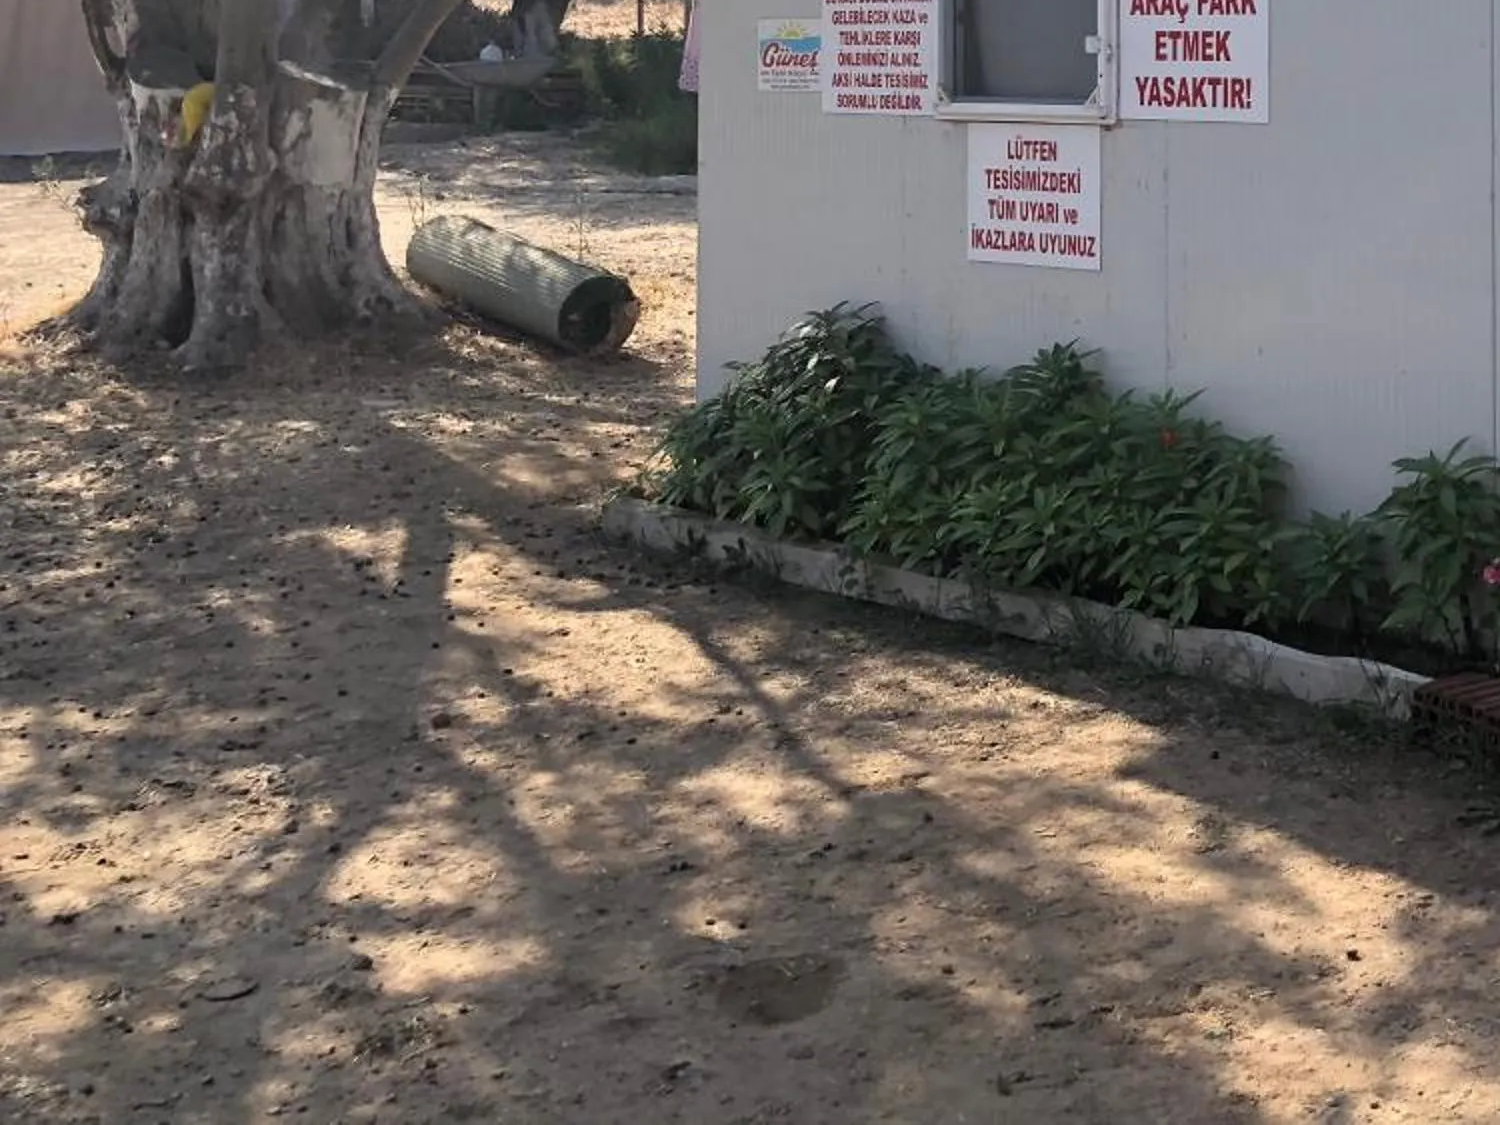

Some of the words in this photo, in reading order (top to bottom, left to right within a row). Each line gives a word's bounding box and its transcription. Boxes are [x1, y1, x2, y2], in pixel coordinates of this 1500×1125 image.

[832, 7, 889, 24] GELEBİLECEK
[892, 9, 917, 24] KAZA
[919, 13, 928, 23] ve
[893, 31, 921, 48] KARŞI
[1155, 30, 1231, 61] ETMEK
[854, 73, 882, 87] HALDE
[1135, 76, 1252, 109] YASAKTIR!
[837, 94, 877, 109] SORUMLU
[1007, 135, 1057, 161] LÜTFEN
[985, 165, 1081, 194] TESİSİMİZDEKİ
[988, 195, 1016, 220] TÜM
[1020, 201, 1059, 223] UYARI
[1063, 208, 1079, 224] ve
[971, 223, 1035, 252] İKAZLARA
[1040, 232, 1096, 257] UYUNUZ
